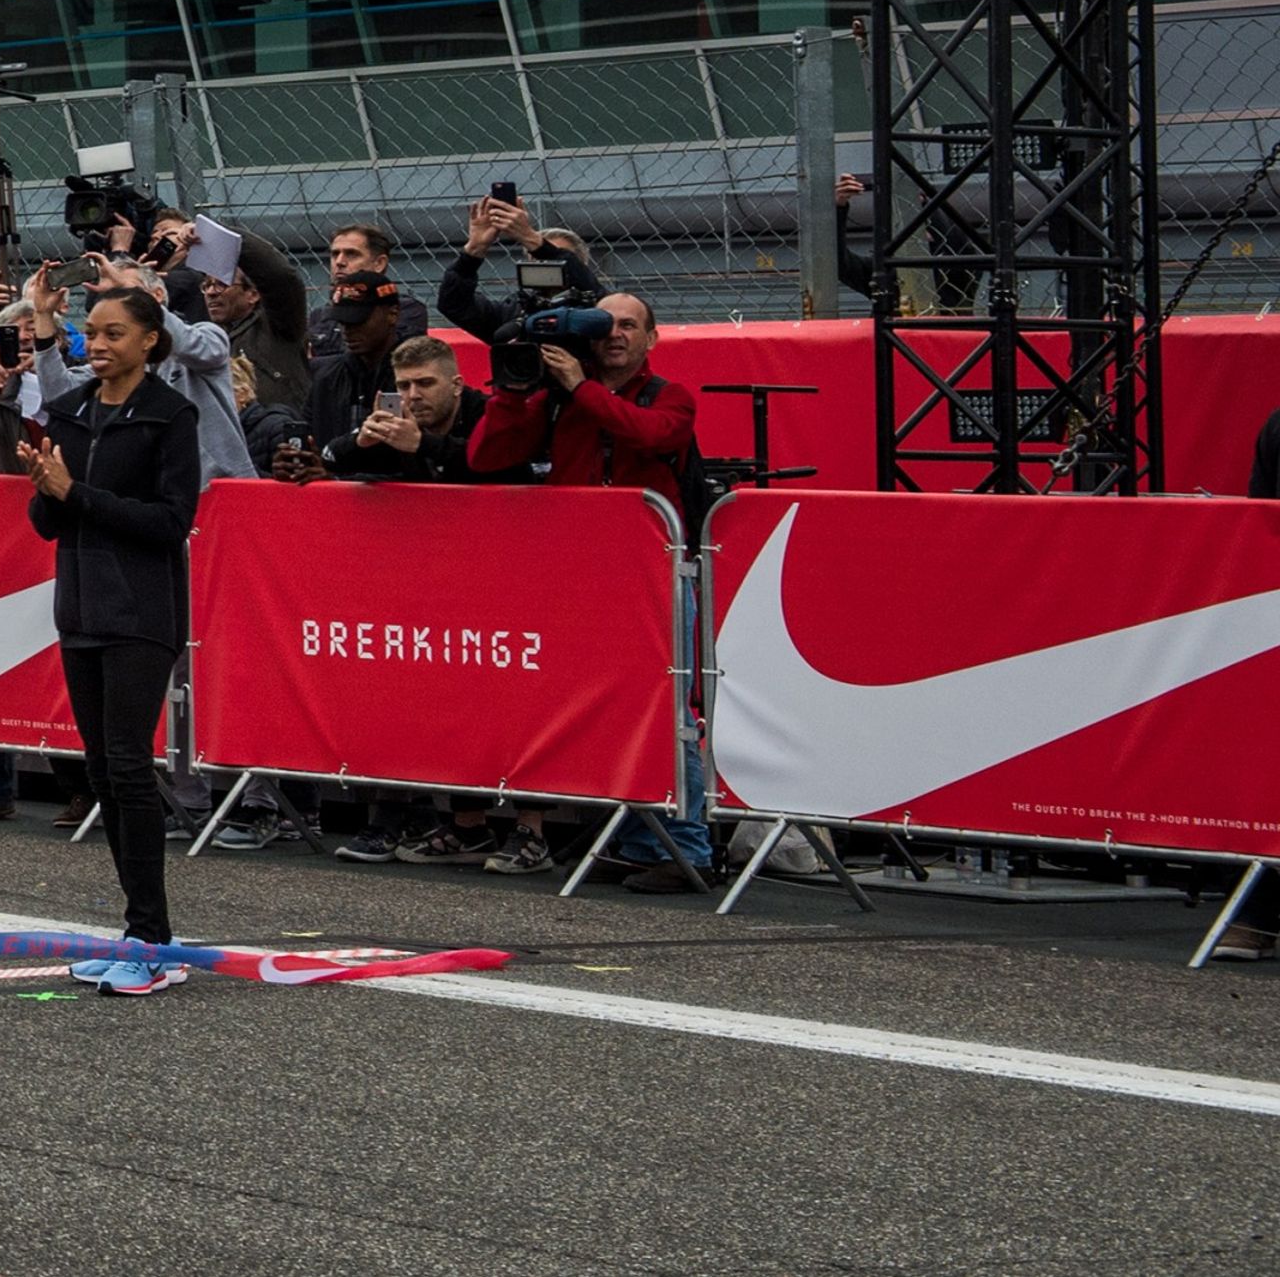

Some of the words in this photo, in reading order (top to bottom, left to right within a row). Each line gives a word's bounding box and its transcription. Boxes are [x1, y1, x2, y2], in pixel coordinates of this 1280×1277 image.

[302, 619, 541, 670] BREAKING2
[1011, 802, 1031, 812] THE
[1034, 804, 1068, 815] QUEST
[1072, 807, 1086, 817] TO
[1089, 809, 1122, 820] BREAK
[1126, 811, 1146, 822] THE
[1149, 814, 1190, 825] 2-HOUR
[1193, 817, 1250, 830] MARATHON
